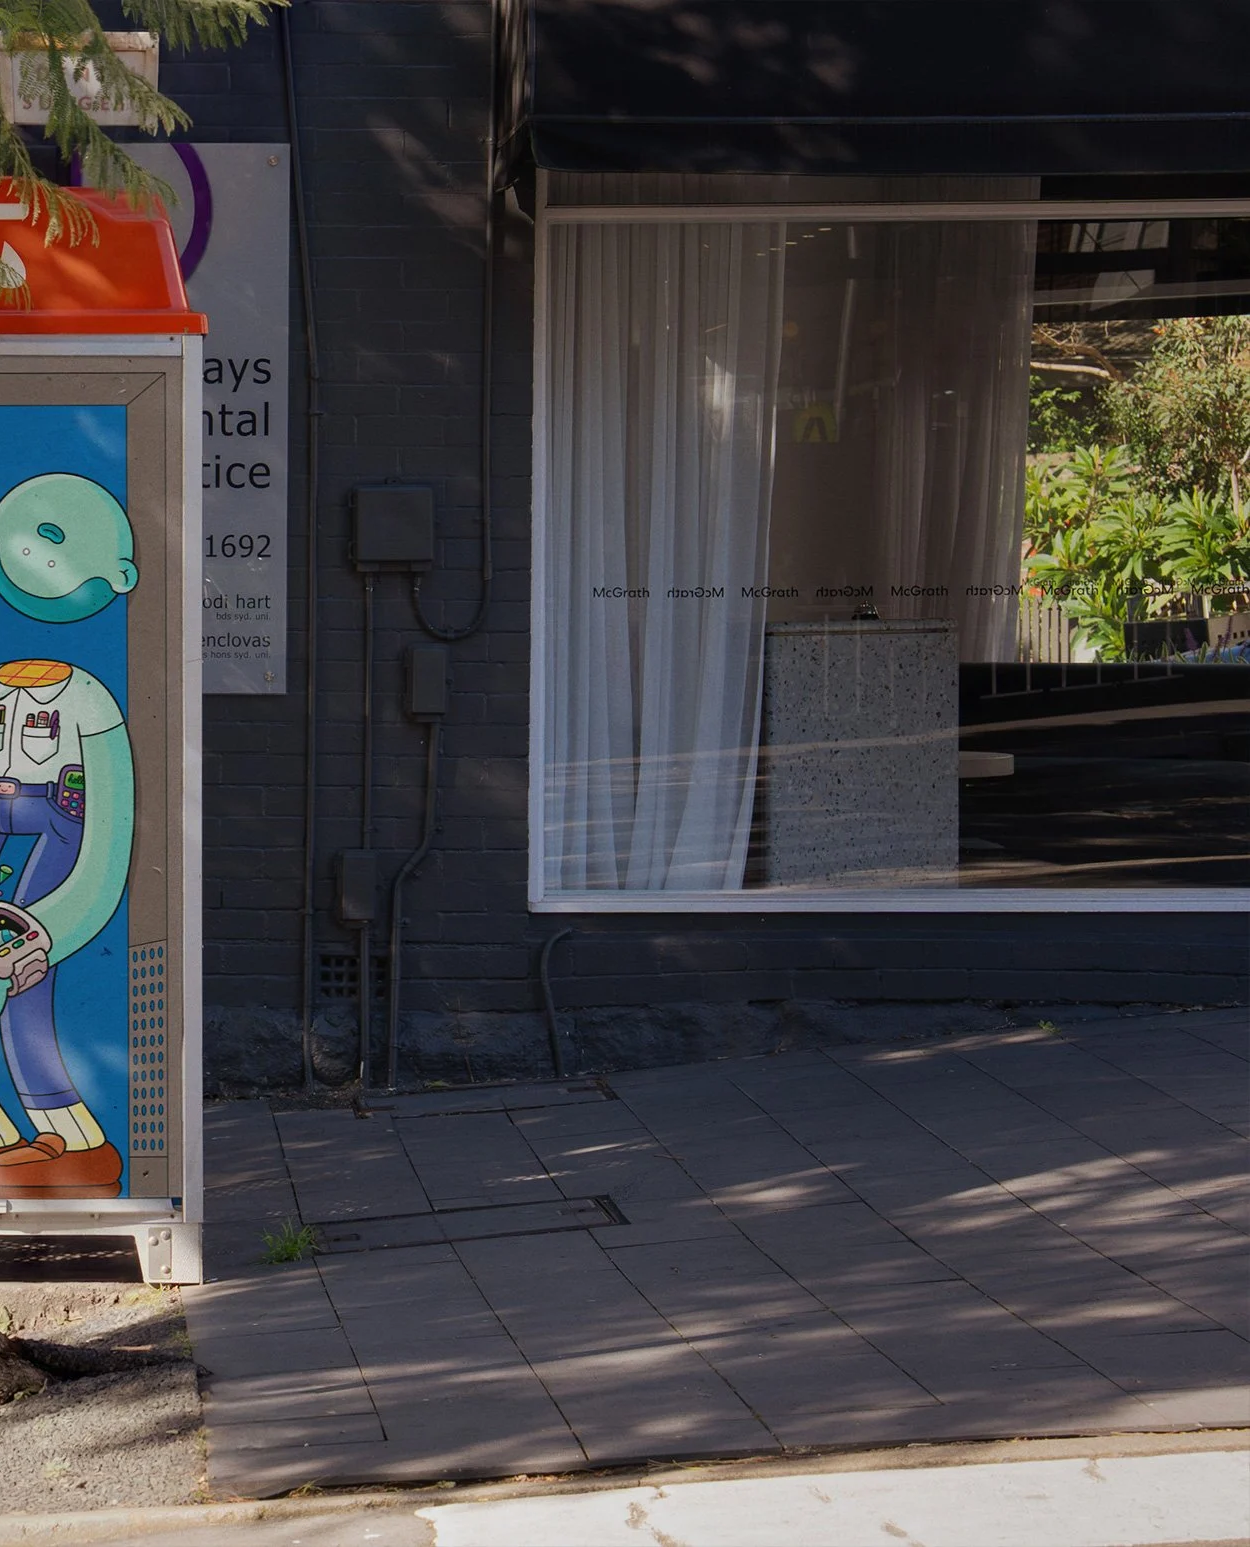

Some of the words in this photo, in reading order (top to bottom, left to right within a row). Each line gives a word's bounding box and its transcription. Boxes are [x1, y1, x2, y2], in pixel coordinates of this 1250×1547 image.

[203, 358, 271, 392] ays
[205, 535, 272, 558] 1692
[592, 586, 650, 598] McGrath
[741, 586, 799, 598] McGrath
[891, 585, 948, 597] McGrath
[1041, 584, 1099, 596] McGrath
[202, 594, 228, 609] odi
[236, 594, 271, 609] hart
